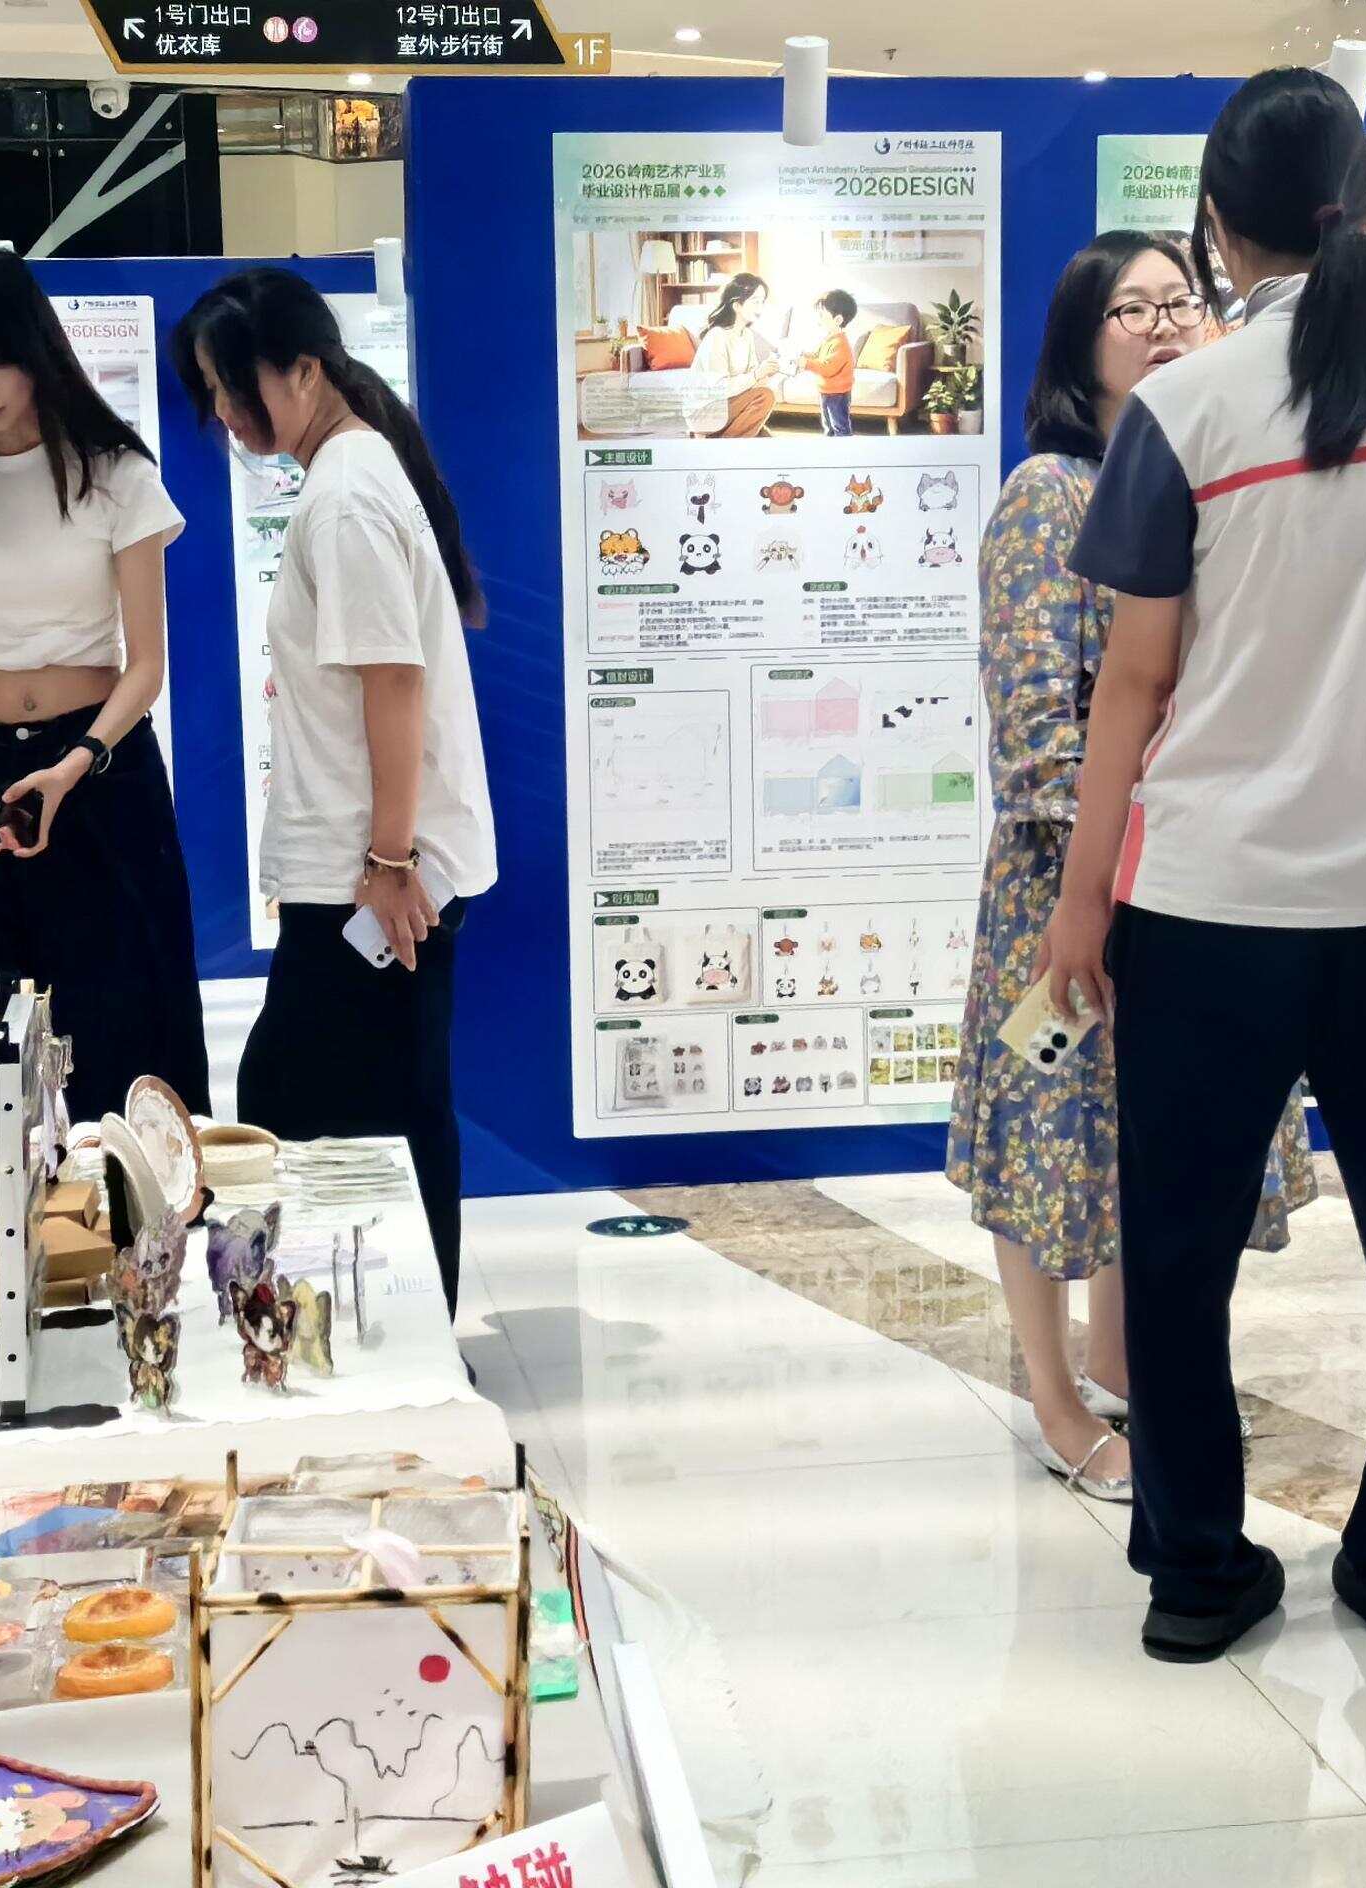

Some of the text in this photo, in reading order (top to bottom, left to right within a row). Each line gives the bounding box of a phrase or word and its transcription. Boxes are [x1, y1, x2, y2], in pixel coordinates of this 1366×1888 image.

[155, 4, 251, 26] 1号门出口
[397, 5, 501, 26] 12号门出口
[155, 34, 221, 56] 优衣库
[397, 34, 503, 57] 室外步行街
[574, 39, 605, 65] 1F
[582, 163, 726, 179] 2026岭南艺术产业系
[582, 183, 681, 198] 毕业设计作品展
[835, 176, 974, 196] 2026DESIGN
[603, 451, 648, 464] 主题设计
